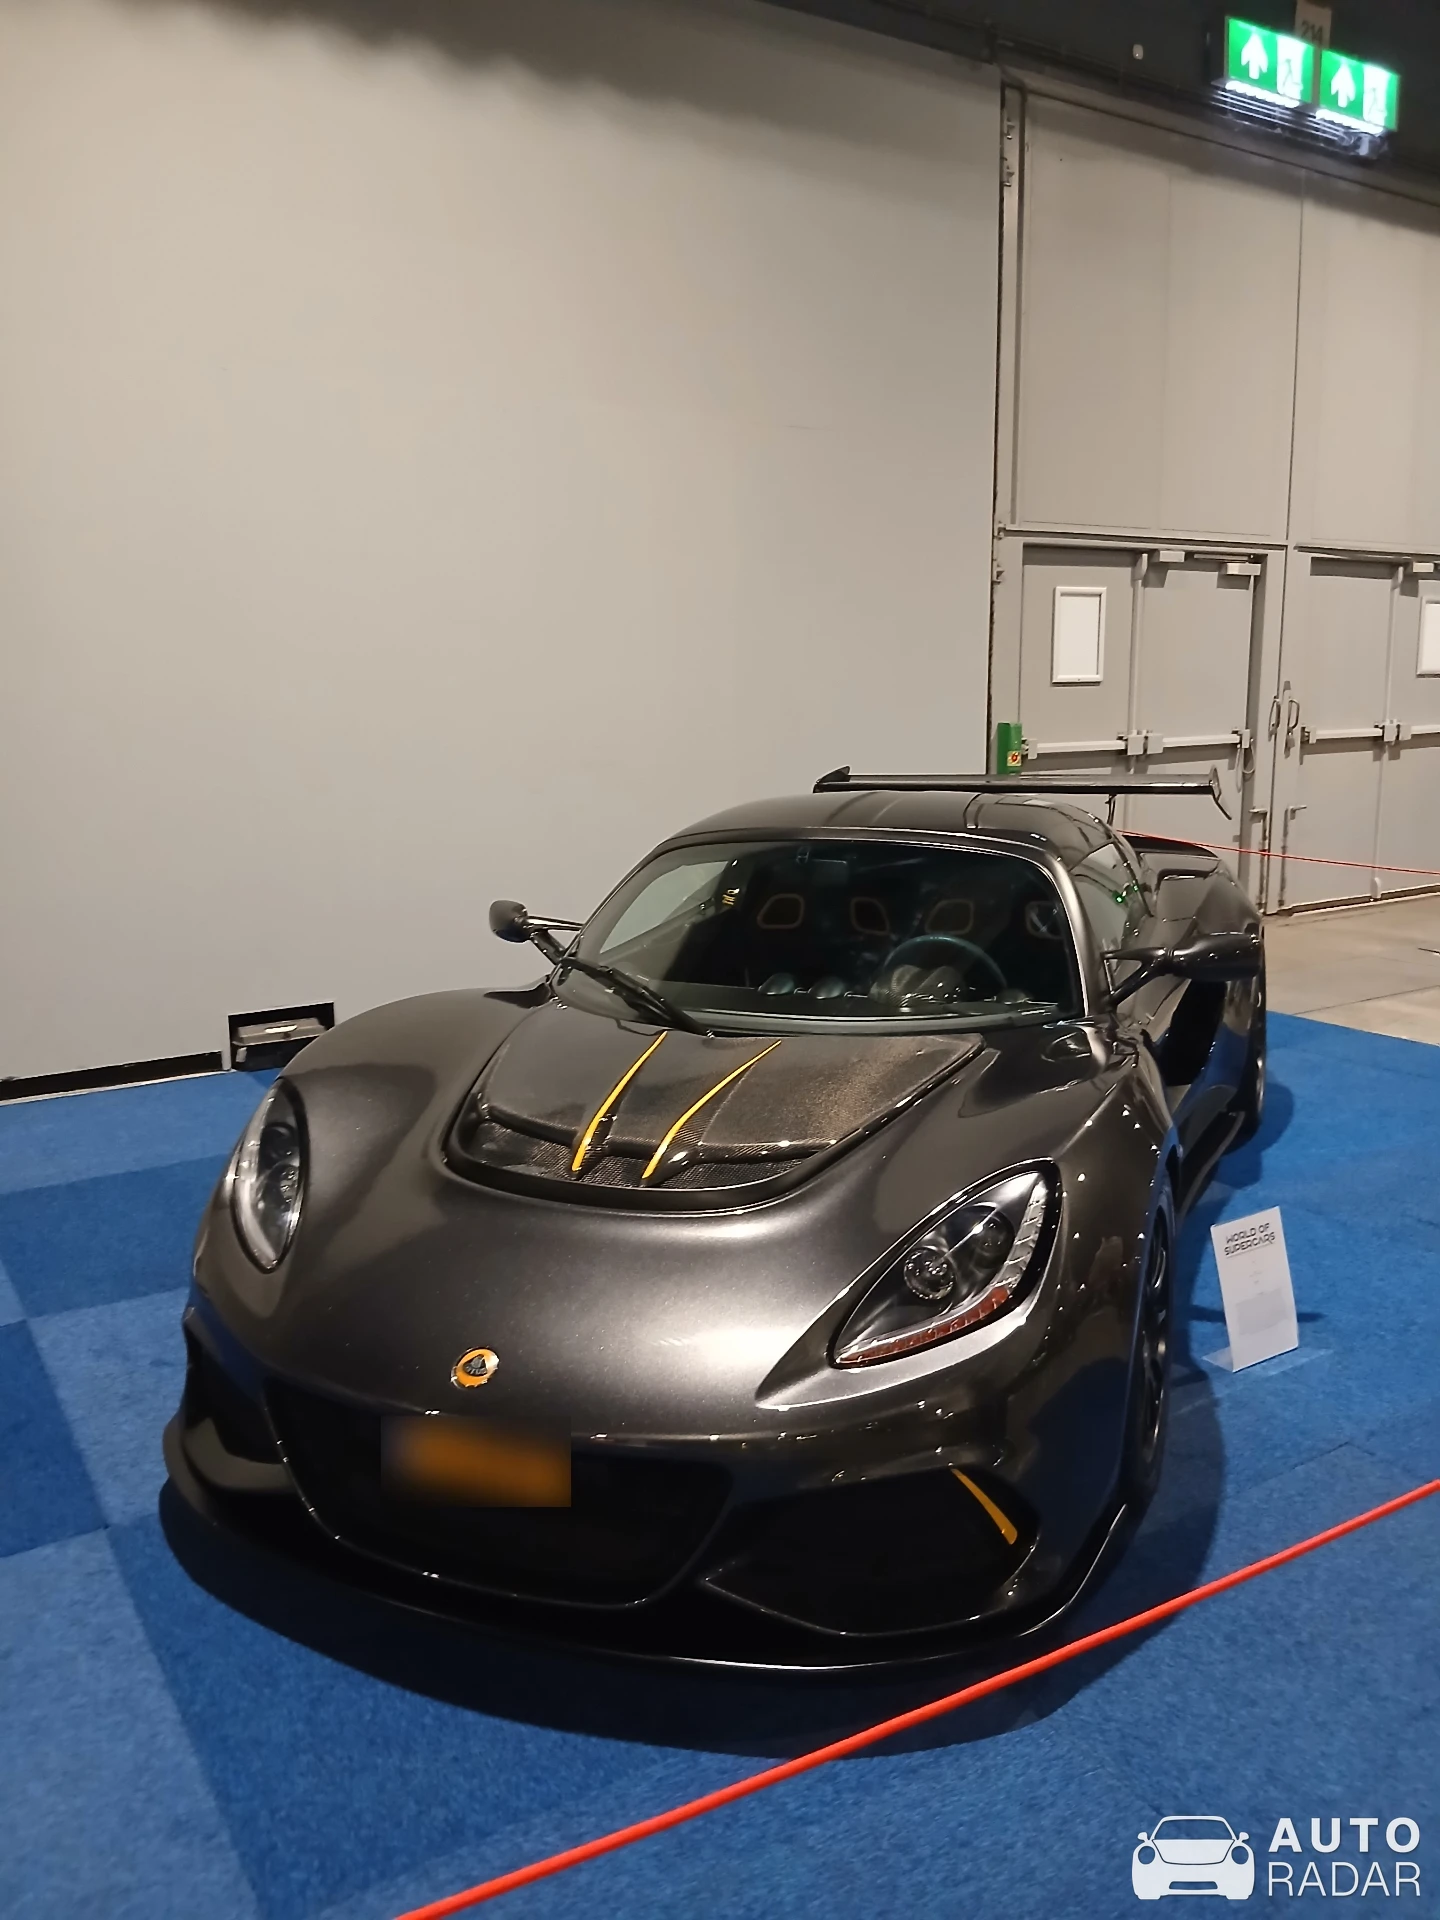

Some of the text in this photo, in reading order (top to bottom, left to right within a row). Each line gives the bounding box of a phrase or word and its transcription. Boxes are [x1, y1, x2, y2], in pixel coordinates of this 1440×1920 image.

[1224, 1231, 1275, 1256] SUPERCARS
[1226, 1222, 1270, 1244] WORLD OF
